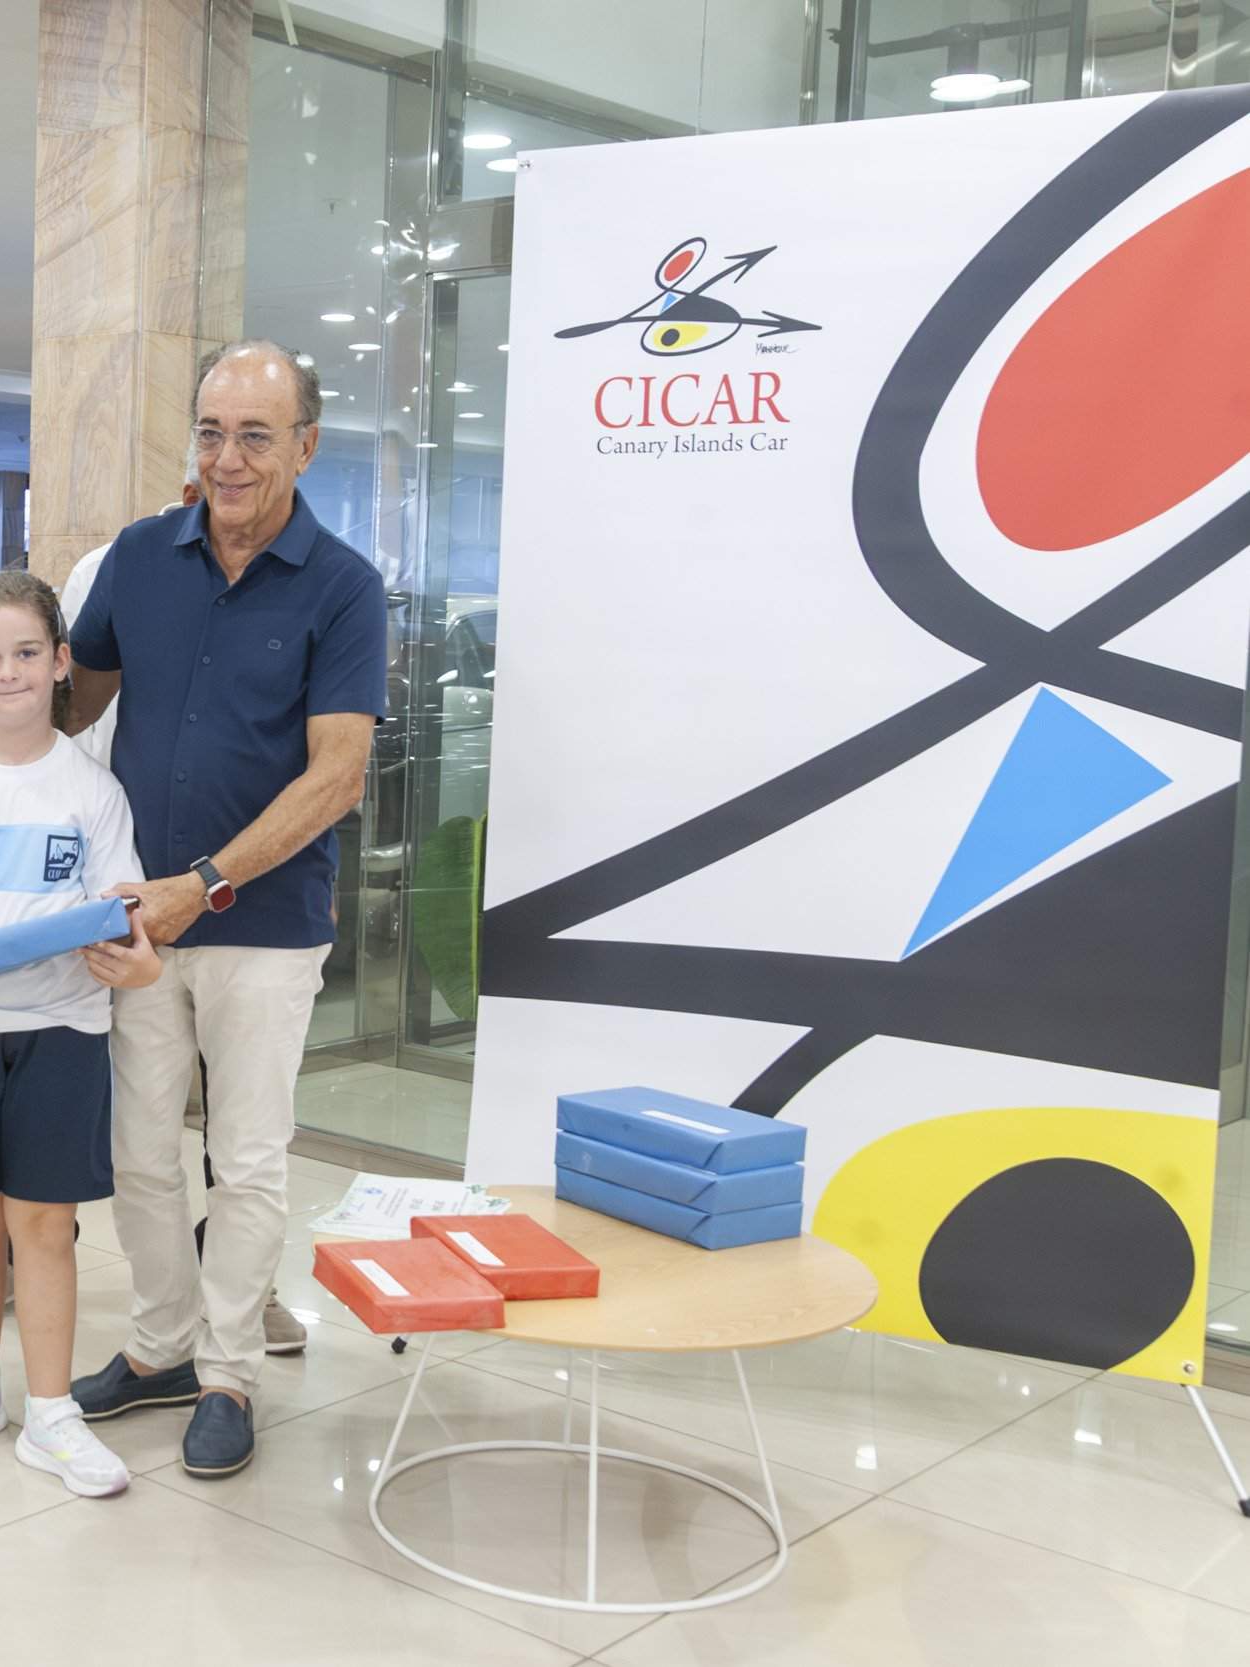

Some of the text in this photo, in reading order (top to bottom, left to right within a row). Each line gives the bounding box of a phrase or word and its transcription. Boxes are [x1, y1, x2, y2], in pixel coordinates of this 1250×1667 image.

[594, 371, 790, 428] CICAR
[597, 432, 788, 460] Canary Islands Car
